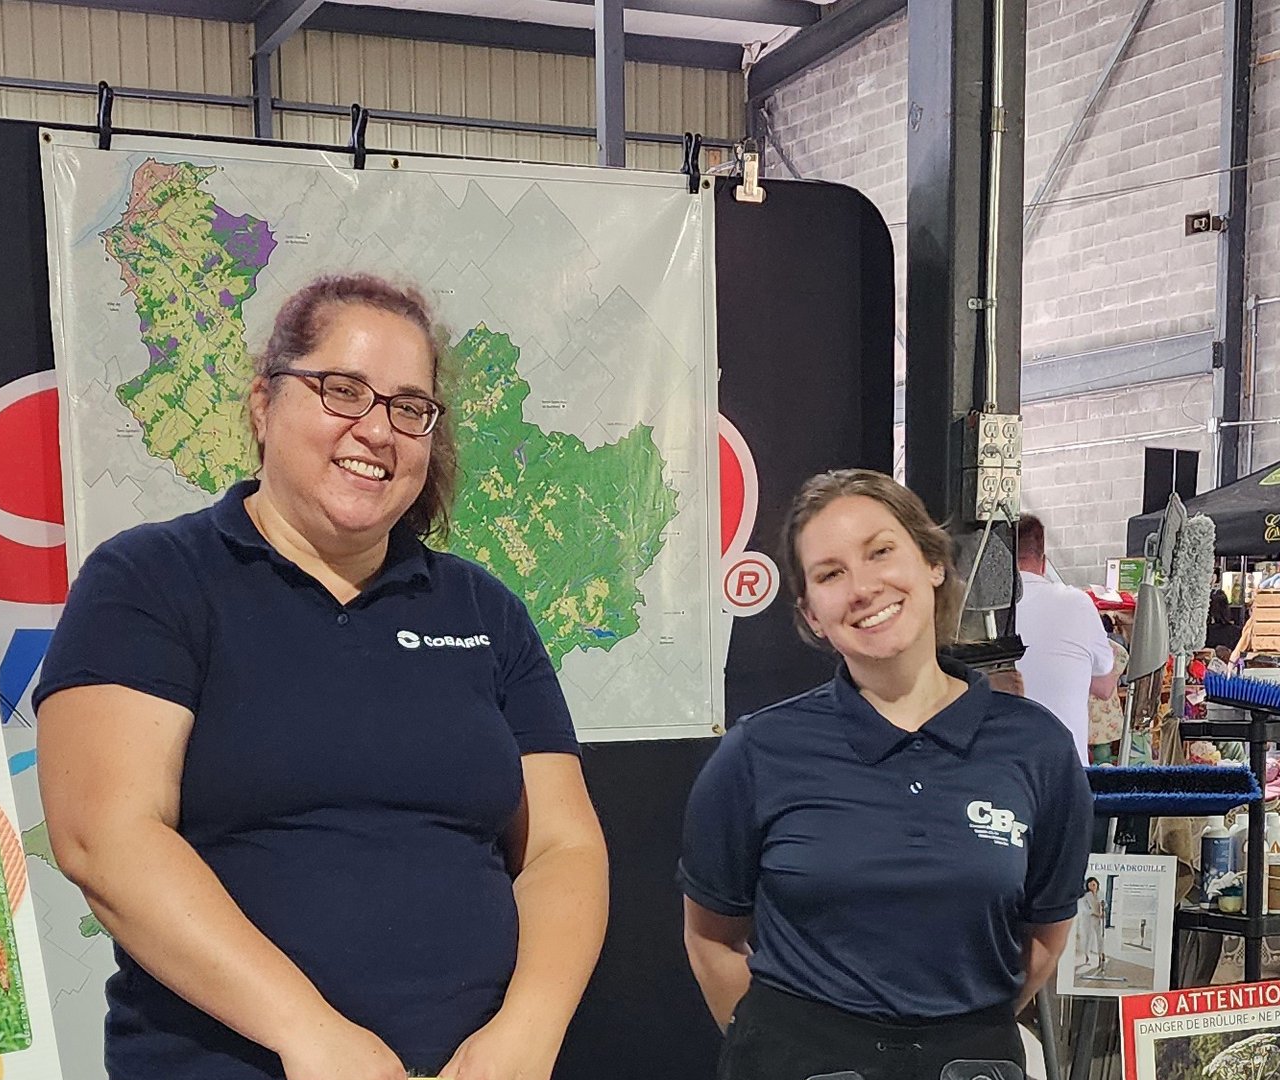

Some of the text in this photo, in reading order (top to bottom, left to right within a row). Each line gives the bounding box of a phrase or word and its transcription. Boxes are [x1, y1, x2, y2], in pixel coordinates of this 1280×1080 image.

[423, 634, 490, 648] COBARIC
[1139, 1020, 1183, 1034] DANGER
[1186, 1018, 1199, 1030] DE
[1202, 1013, 1249, 1028] BRÛLURE
[1258, 1010, 1272, 1022] NE
